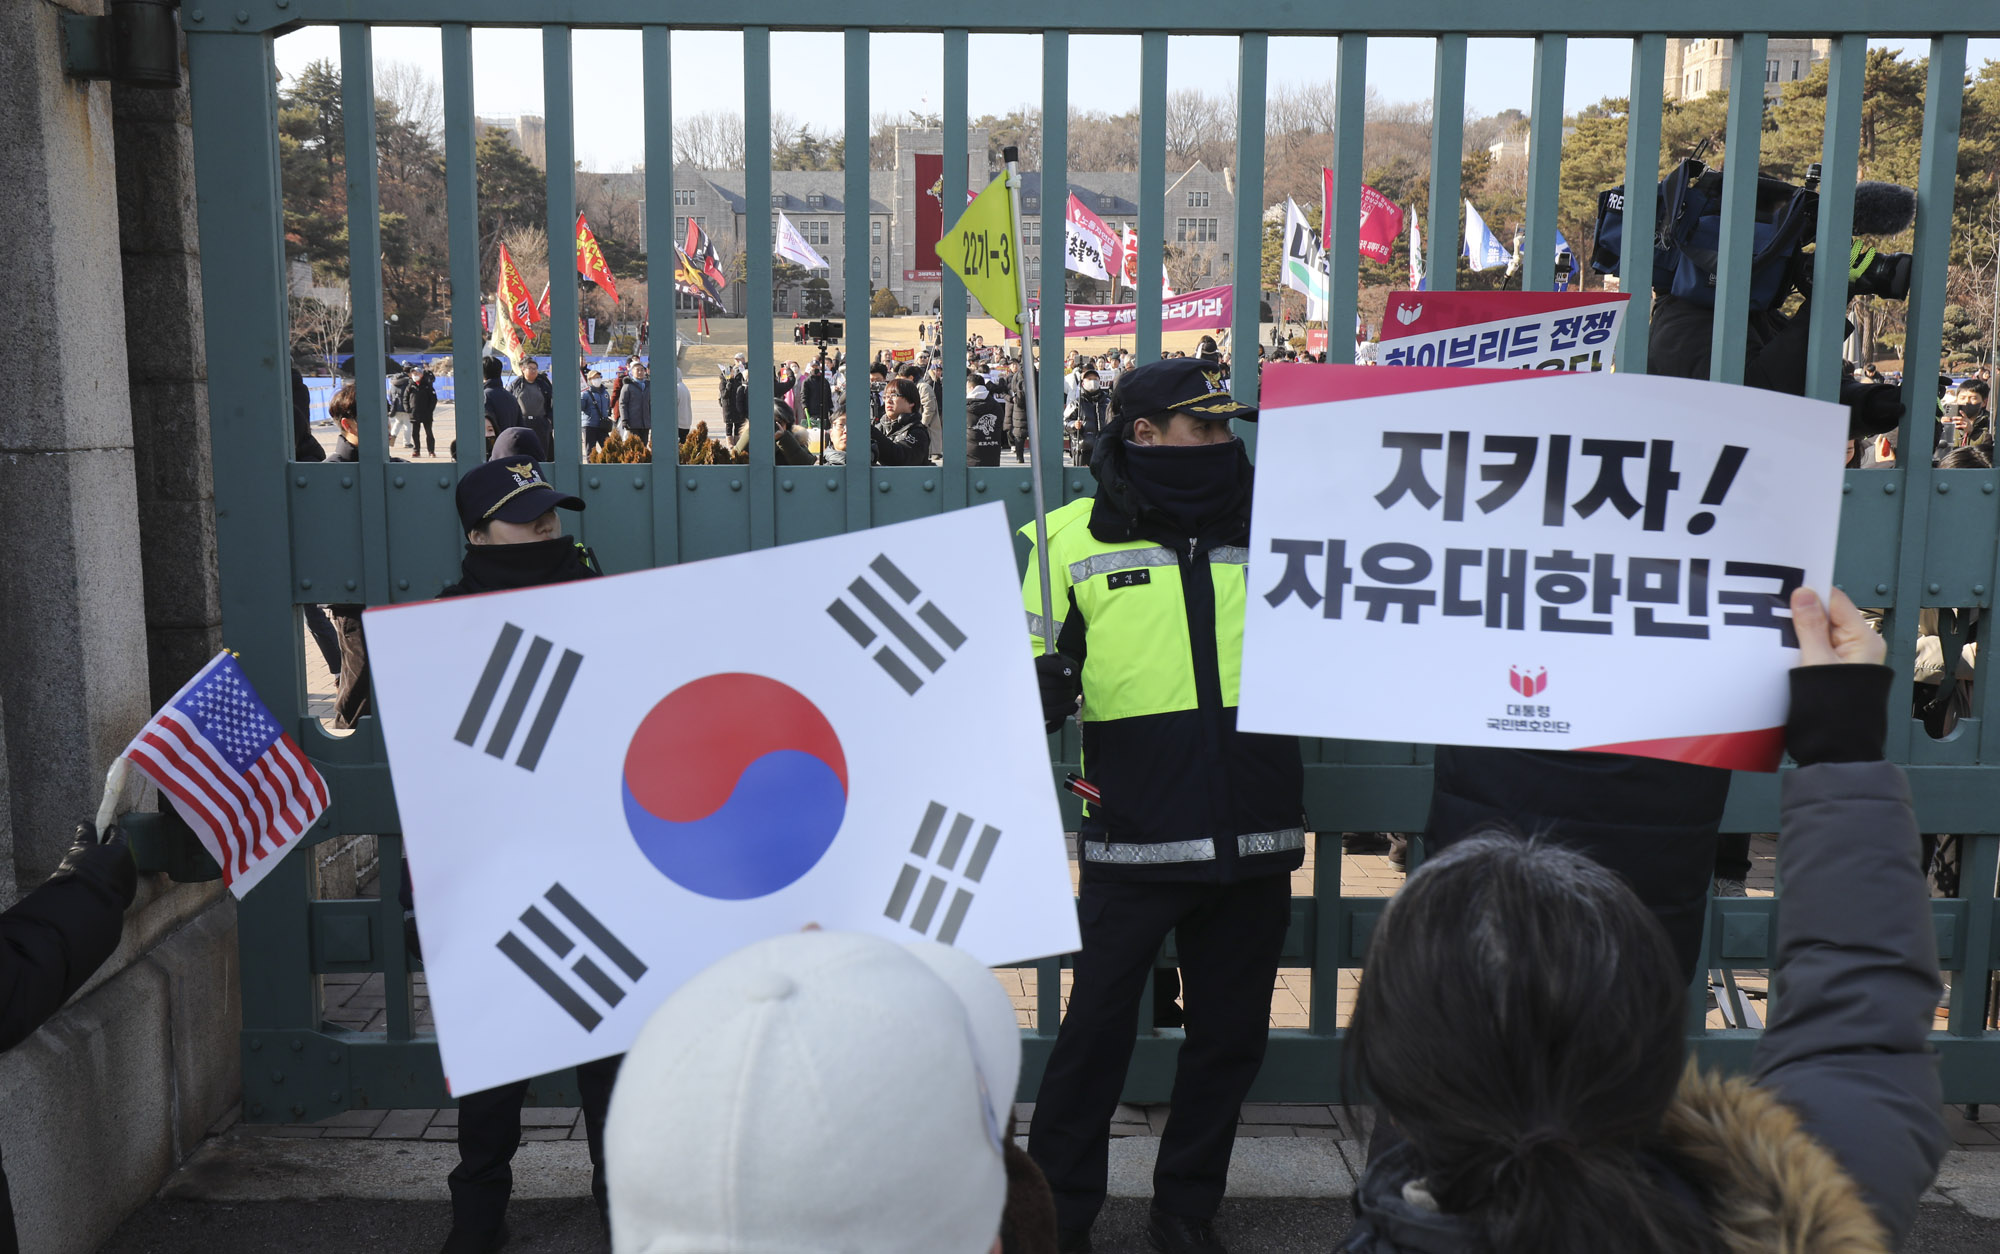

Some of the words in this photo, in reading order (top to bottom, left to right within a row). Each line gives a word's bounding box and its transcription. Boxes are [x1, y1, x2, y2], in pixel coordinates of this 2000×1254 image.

[1607, 193, 1625, 210] PRE
[1080, 216, 1115, 247] 노동자연대
[963, 230, 1010, 278] 22기-3
[1074, 310, 1109, 327] 옹호
[1385, 323, 1541, 368] 하이브리드
[1550, 310, 1617, 352] 전쟁
[1373, 430, 1749, 535] 지키자!
[1263, 538, 1806, 650] 자유대한민국
[1486, 718, 1571, 734] 국민변호인단
[1506, 703, 1551, 718] 대통령
